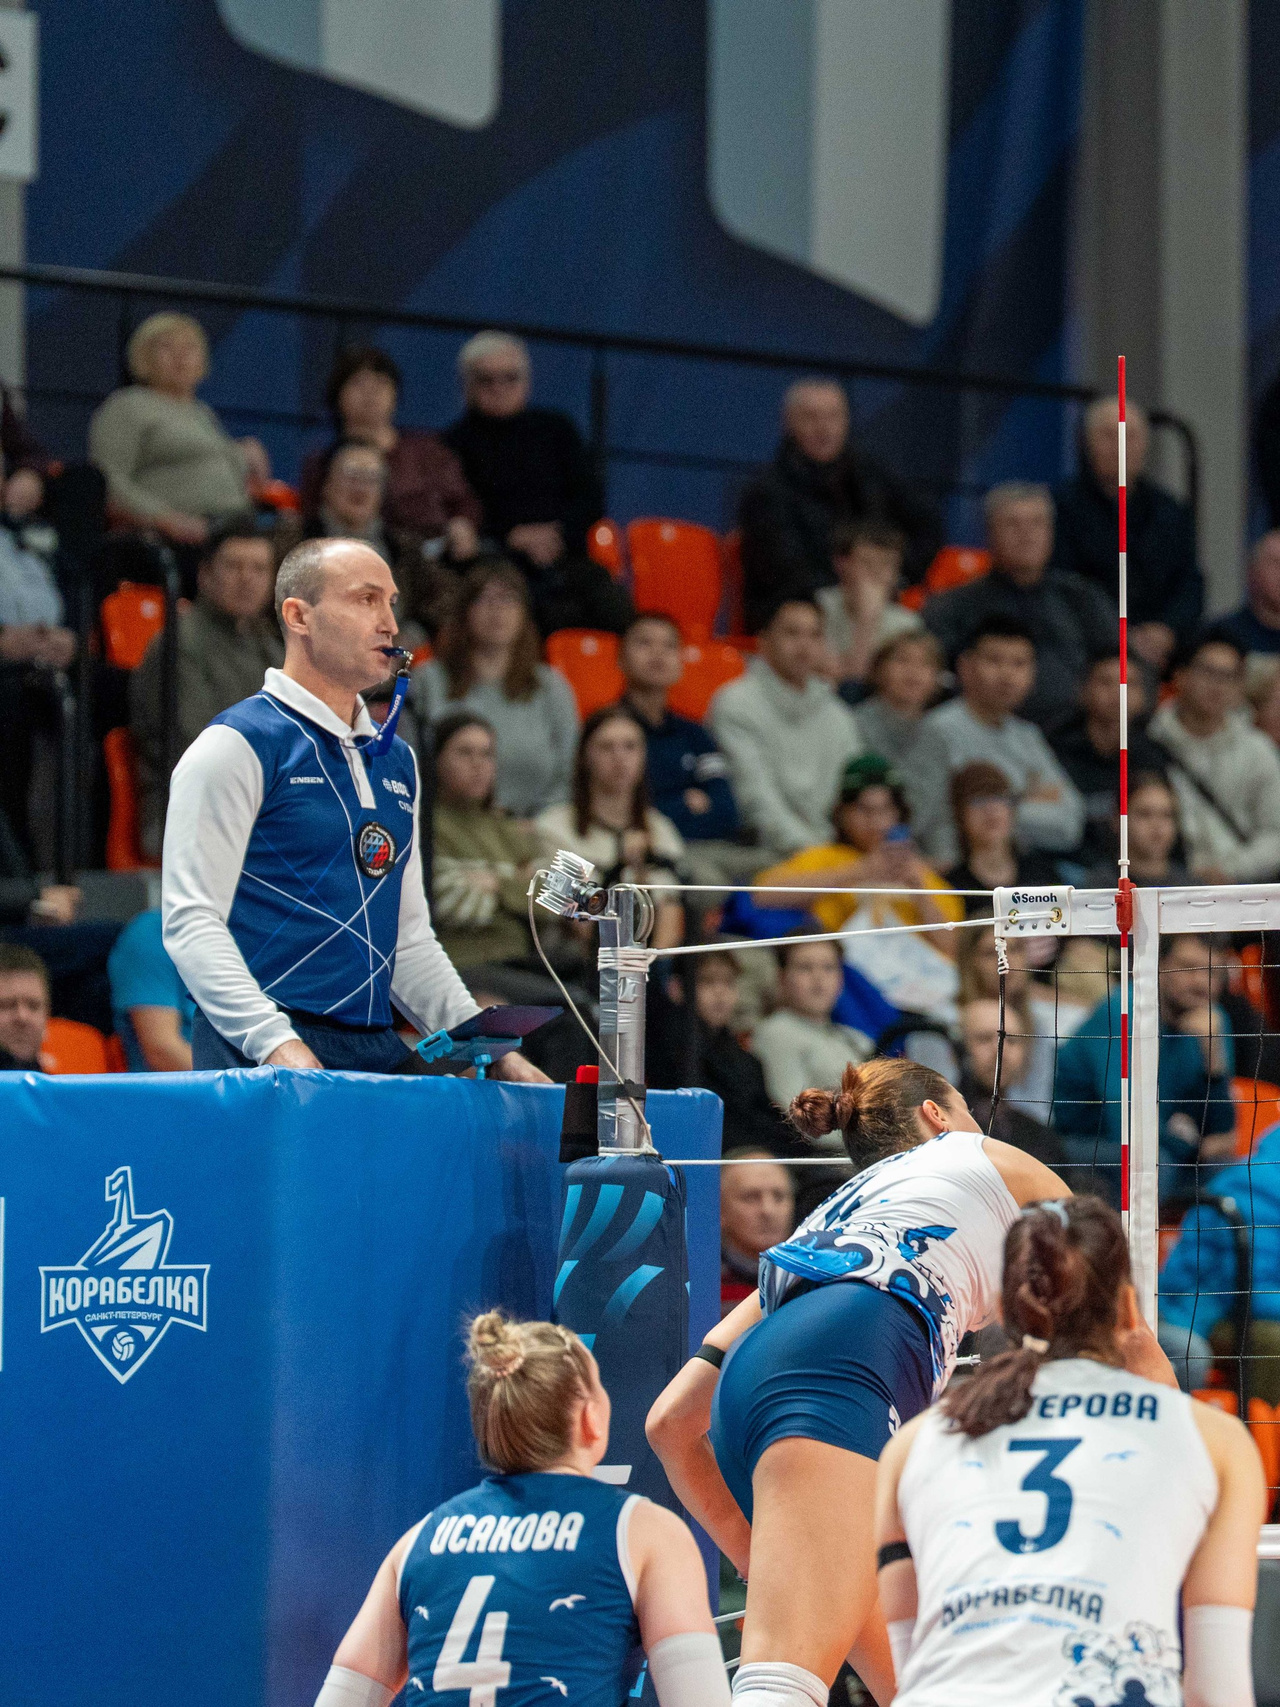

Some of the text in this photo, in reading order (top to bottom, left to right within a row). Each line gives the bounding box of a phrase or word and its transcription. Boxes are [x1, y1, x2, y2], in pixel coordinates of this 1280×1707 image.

[1021, 892, 1058, 904] Senoh
[49, 1275, 200, 1317] КОРАБЕЛКА
[84, 1310, 163, 1322] САНКТ-ПЕТЕРБУРГ
[1034, 1391, 1159, 1421] ЕРОВА
[994, 1437, 1084, 1555] 3
[429, 1510, 586, 1556] ИСАКОВА
[432, 1574, 512, 1707] 4
